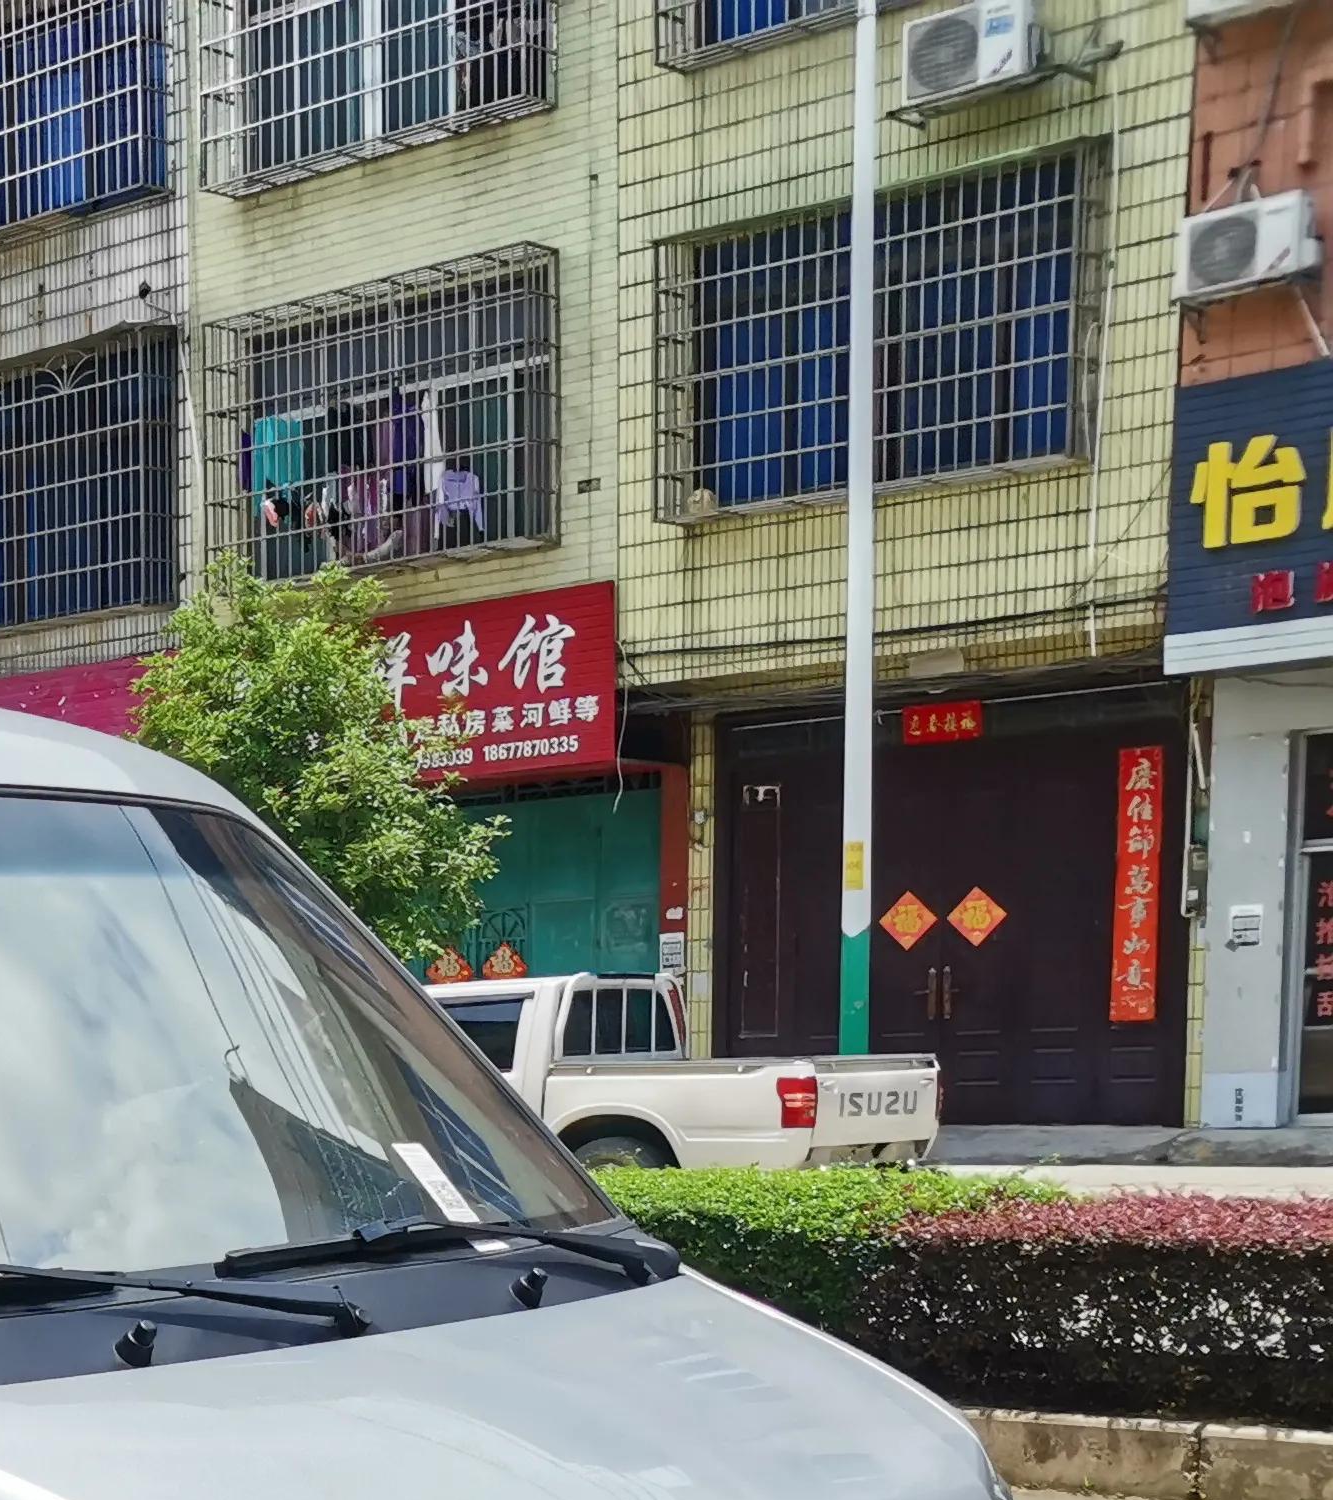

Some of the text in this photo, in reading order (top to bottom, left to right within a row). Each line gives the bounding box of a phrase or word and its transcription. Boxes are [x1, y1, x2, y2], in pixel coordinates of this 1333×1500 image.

[1190, 434, 1333, 549] 怡
[483, 735, 579, 762] 18677870335
[839, 1091, 917, 1117] ISUZU
